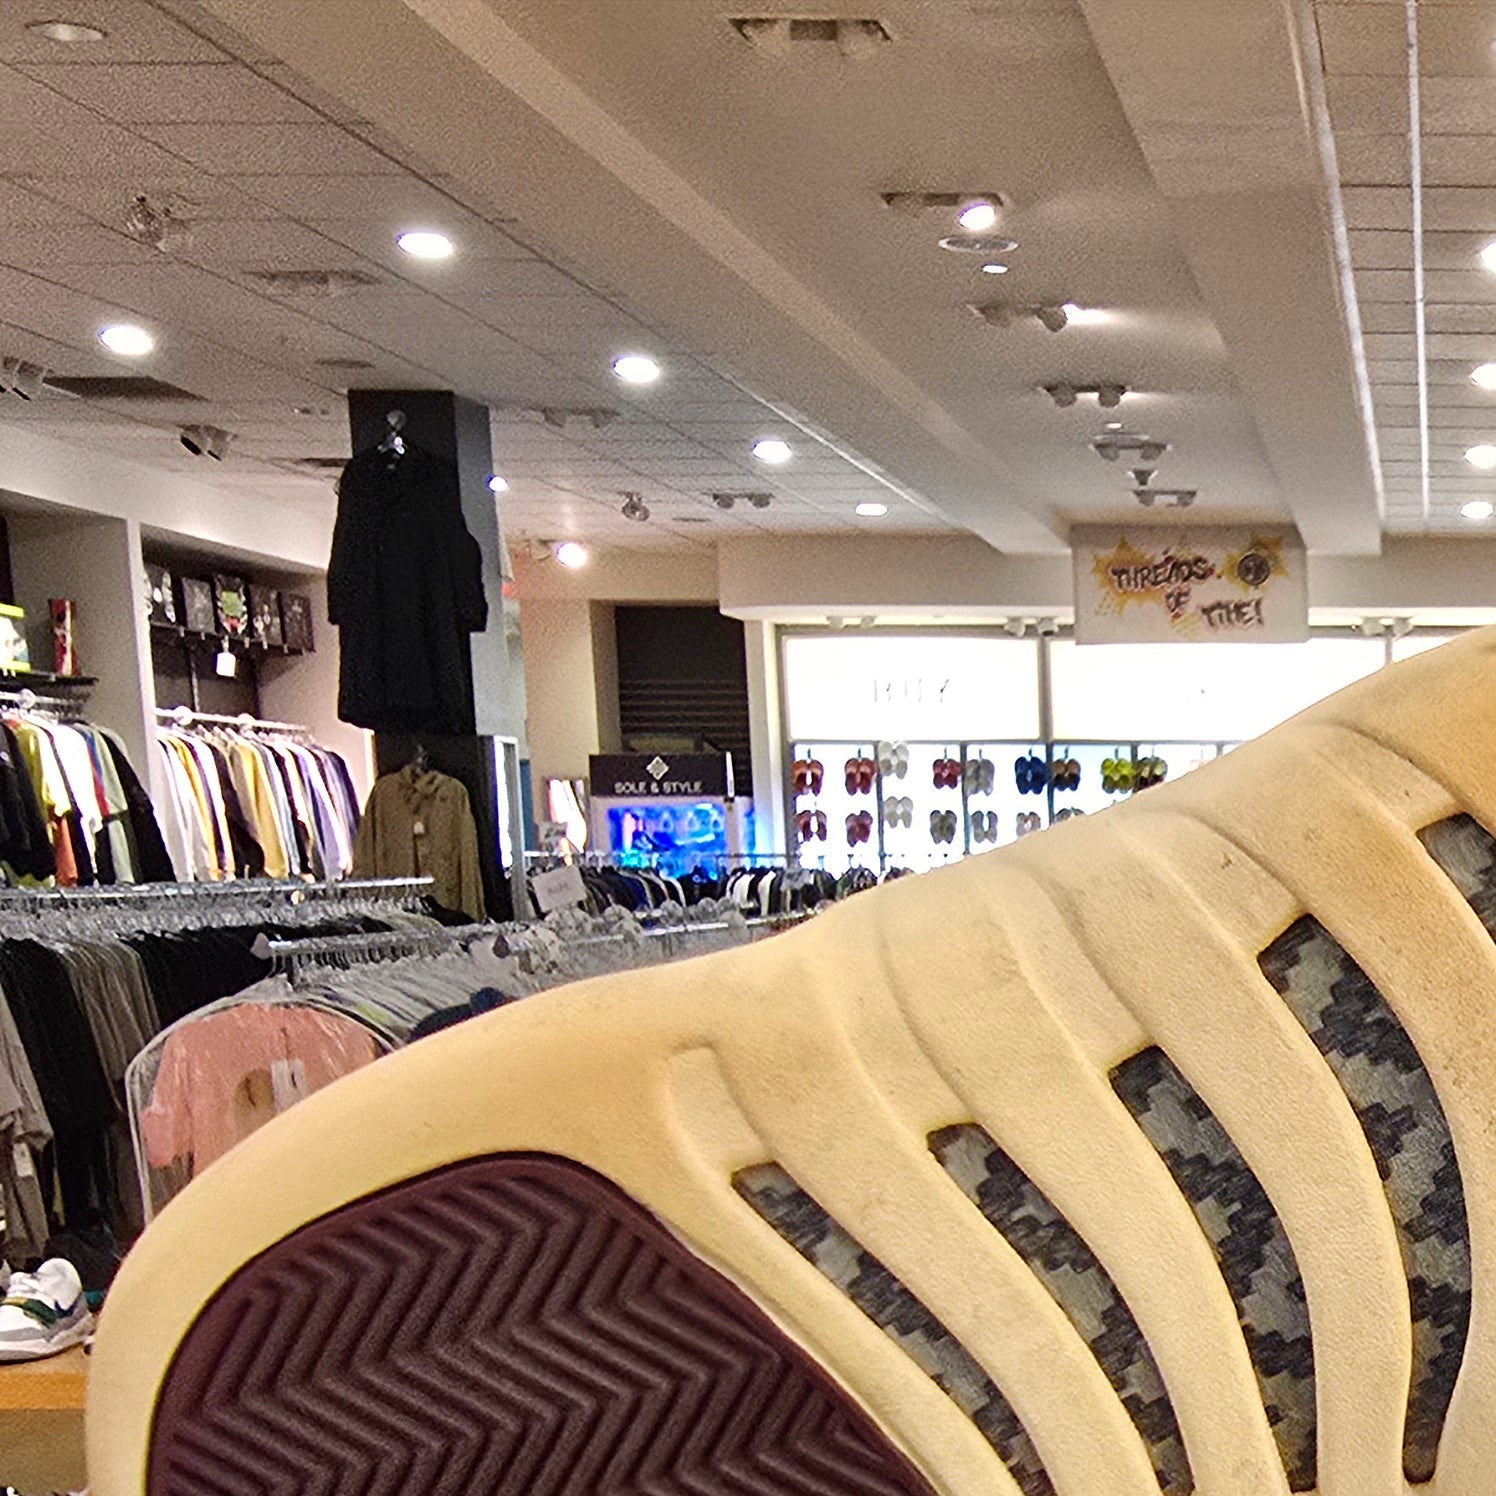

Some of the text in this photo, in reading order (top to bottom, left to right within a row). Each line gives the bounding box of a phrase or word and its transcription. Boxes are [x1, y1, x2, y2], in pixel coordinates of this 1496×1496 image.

[614, 781, 702, 794] SOLE & STYLE
